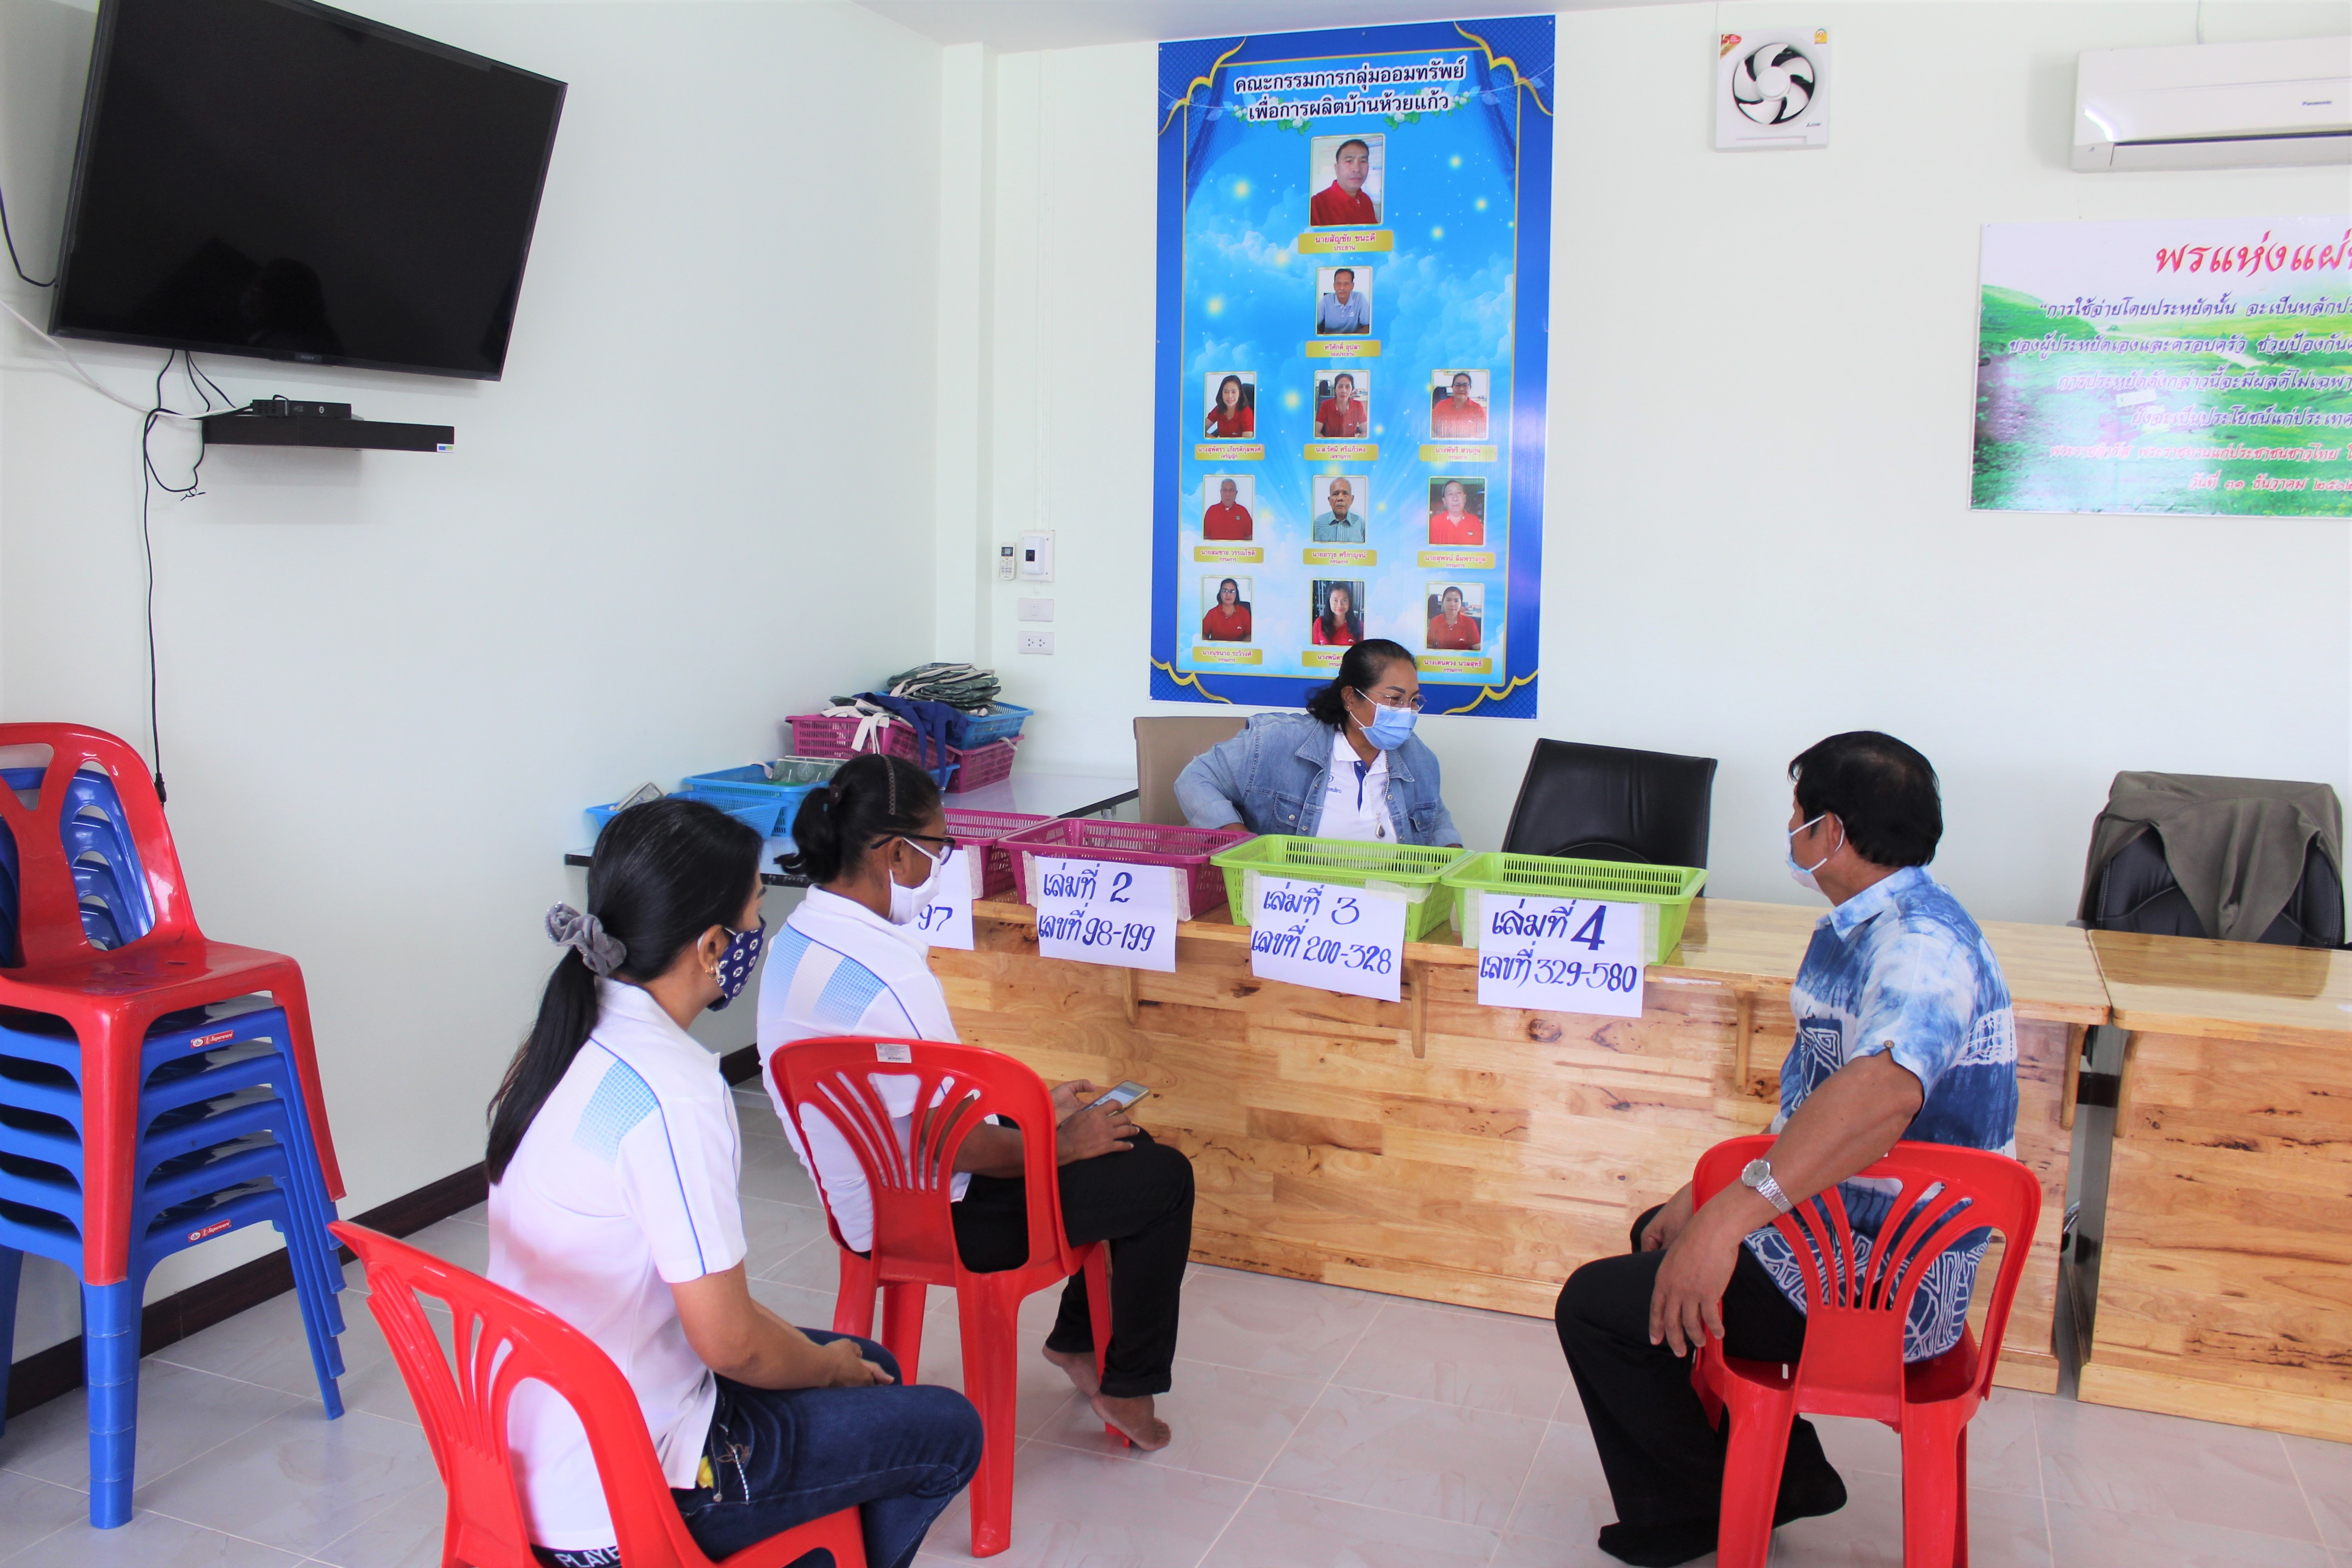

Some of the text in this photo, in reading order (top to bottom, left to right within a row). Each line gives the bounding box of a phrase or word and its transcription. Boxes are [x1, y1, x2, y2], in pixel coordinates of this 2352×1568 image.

[1235, 58, 1465, 92] คณะกรรมการกลุ่มออมทรัพย์
[1249, 90, 1449, 119] เพื่อการผลิตบ้านห้วยแก้ว
[1315, 233, 1375, 244] นายสัญชัย ชนะดี
[2156, 228, 2352, 277] พรแห่งแผ่
[2009, 331, 2246, 359] ของผู้ประหยัดเองและครอบครัว
[2252, 474, 2309, 491] ธันวาคม
[1043, 862, 1133, 903] เล่มที่ 2
[1263, 882, 1360, 926] เล่มที่ 3
[1491, 898, 1607, 951] เล่มที่ 4
